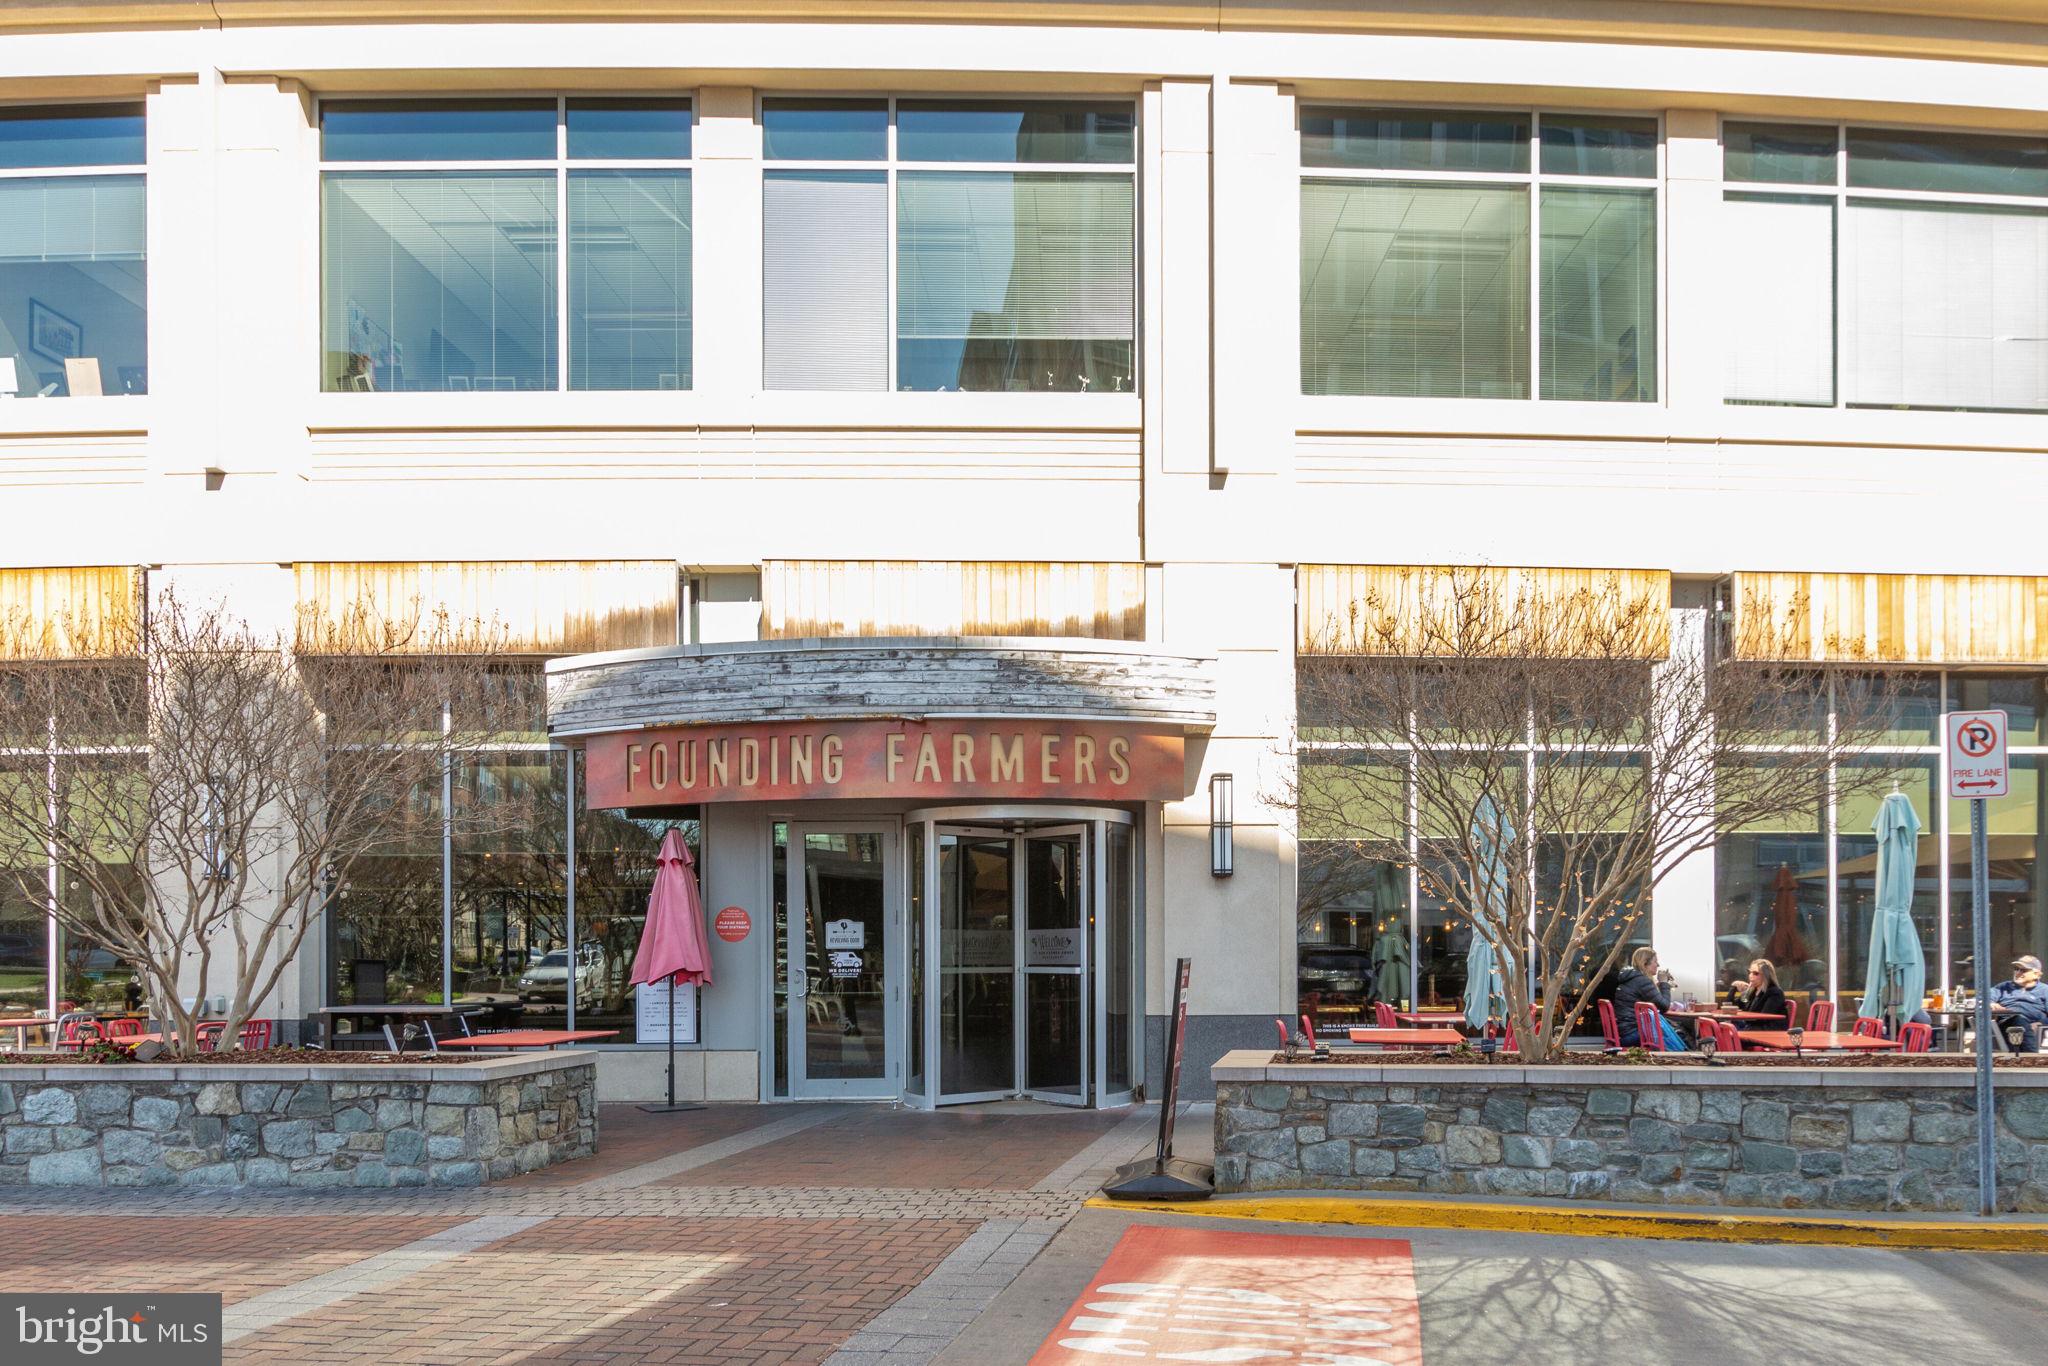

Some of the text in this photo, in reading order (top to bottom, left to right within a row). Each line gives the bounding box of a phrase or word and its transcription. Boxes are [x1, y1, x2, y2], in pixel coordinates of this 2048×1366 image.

[626, 732, 1132, 793] FOUNDING FARMERS
[1953, 768, 2003, 778] FIRE LANE
